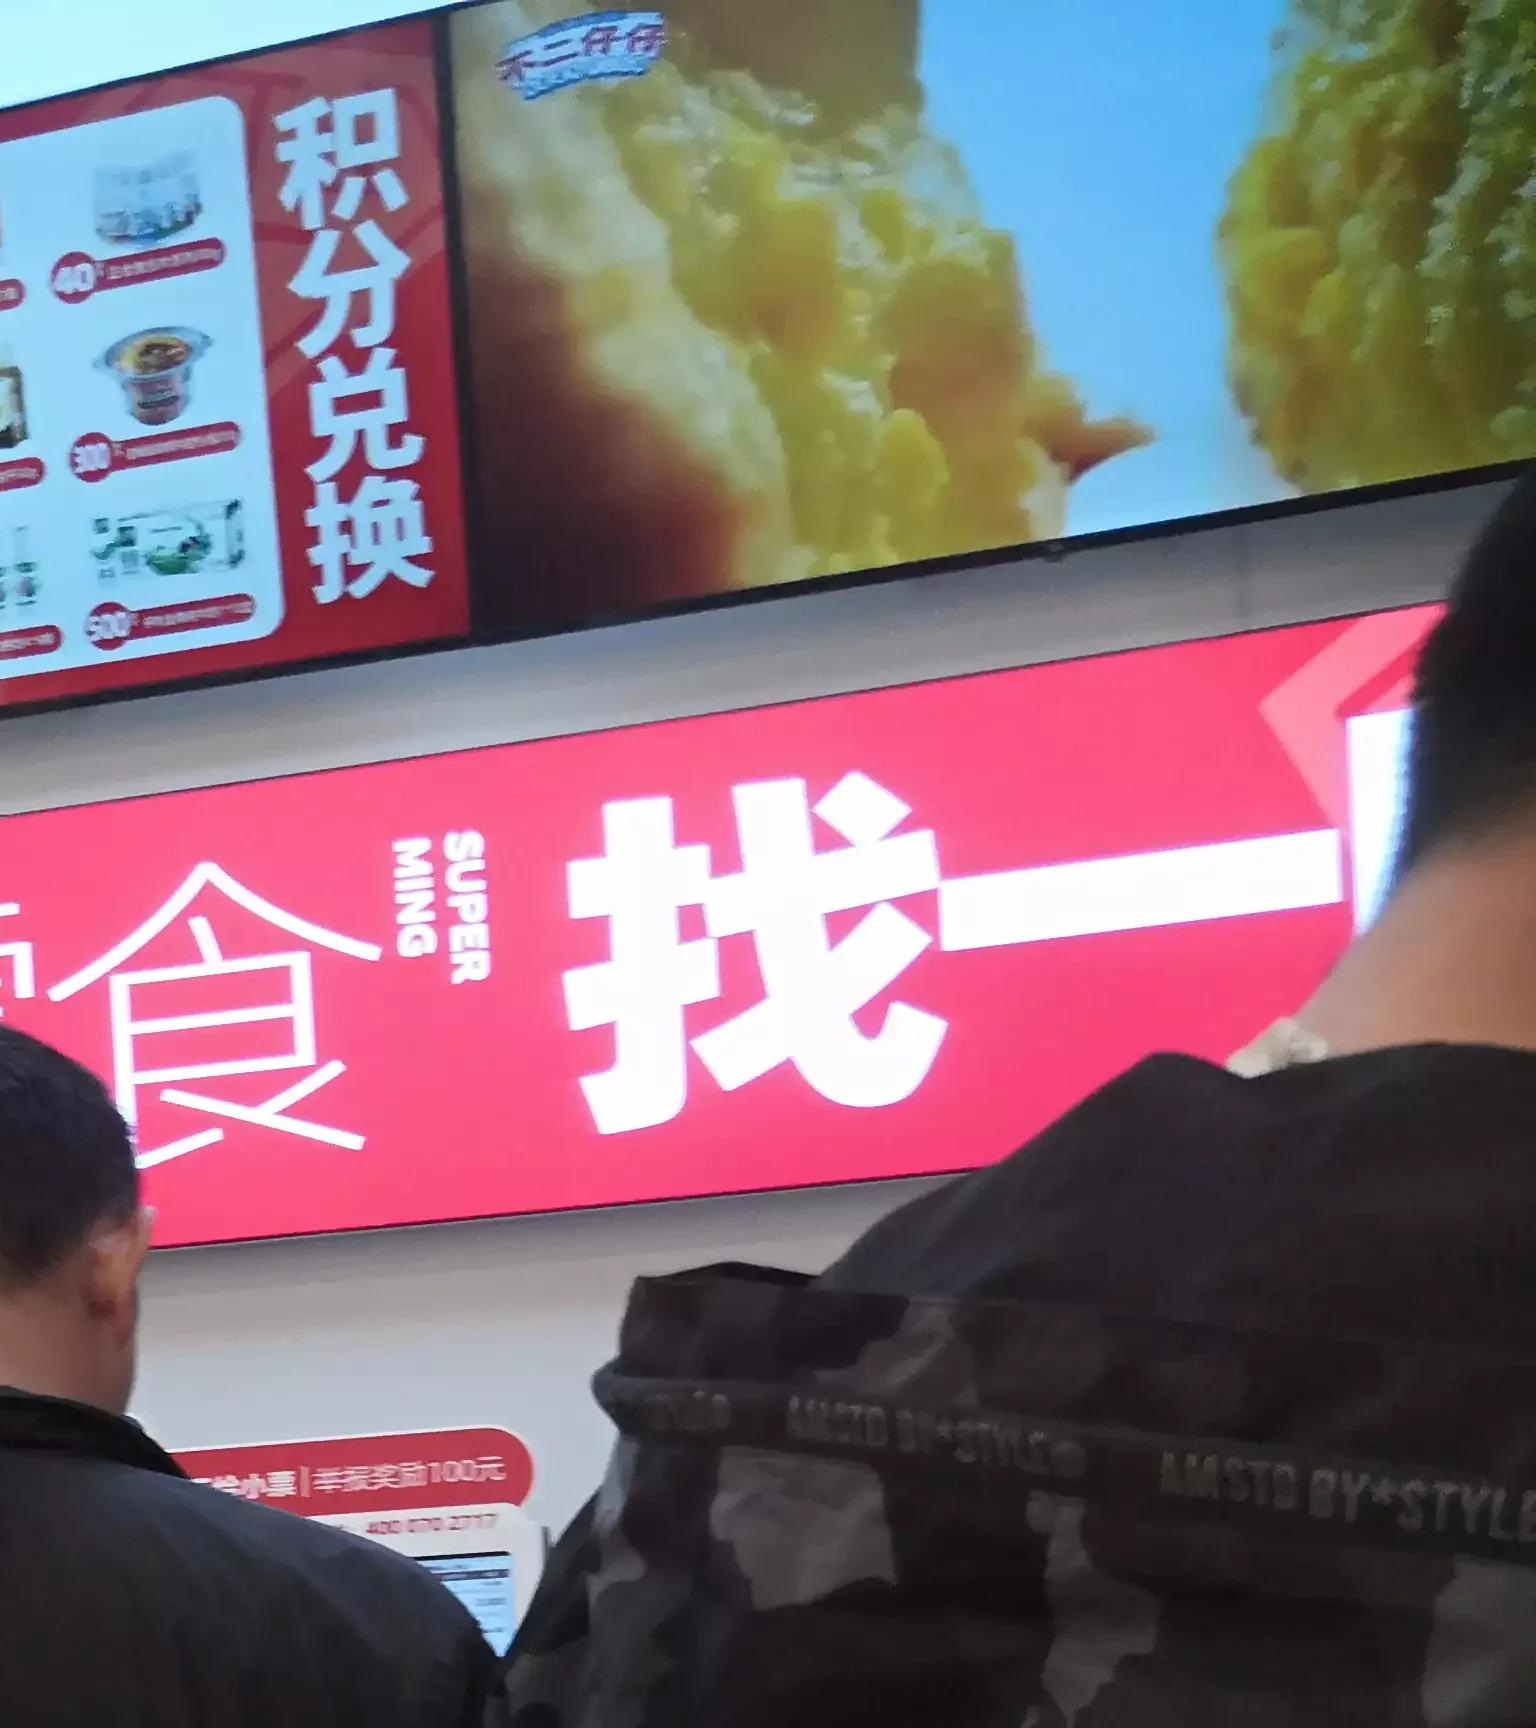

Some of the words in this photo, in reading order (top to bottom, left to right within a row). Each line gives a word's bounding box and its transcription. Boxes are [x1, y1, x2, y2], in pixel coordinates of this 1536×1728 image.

[273, 88, 435, 604] 积分兑换
[391, 836, 436, 960] MING
[443, 829, 492, 984] SUPER
